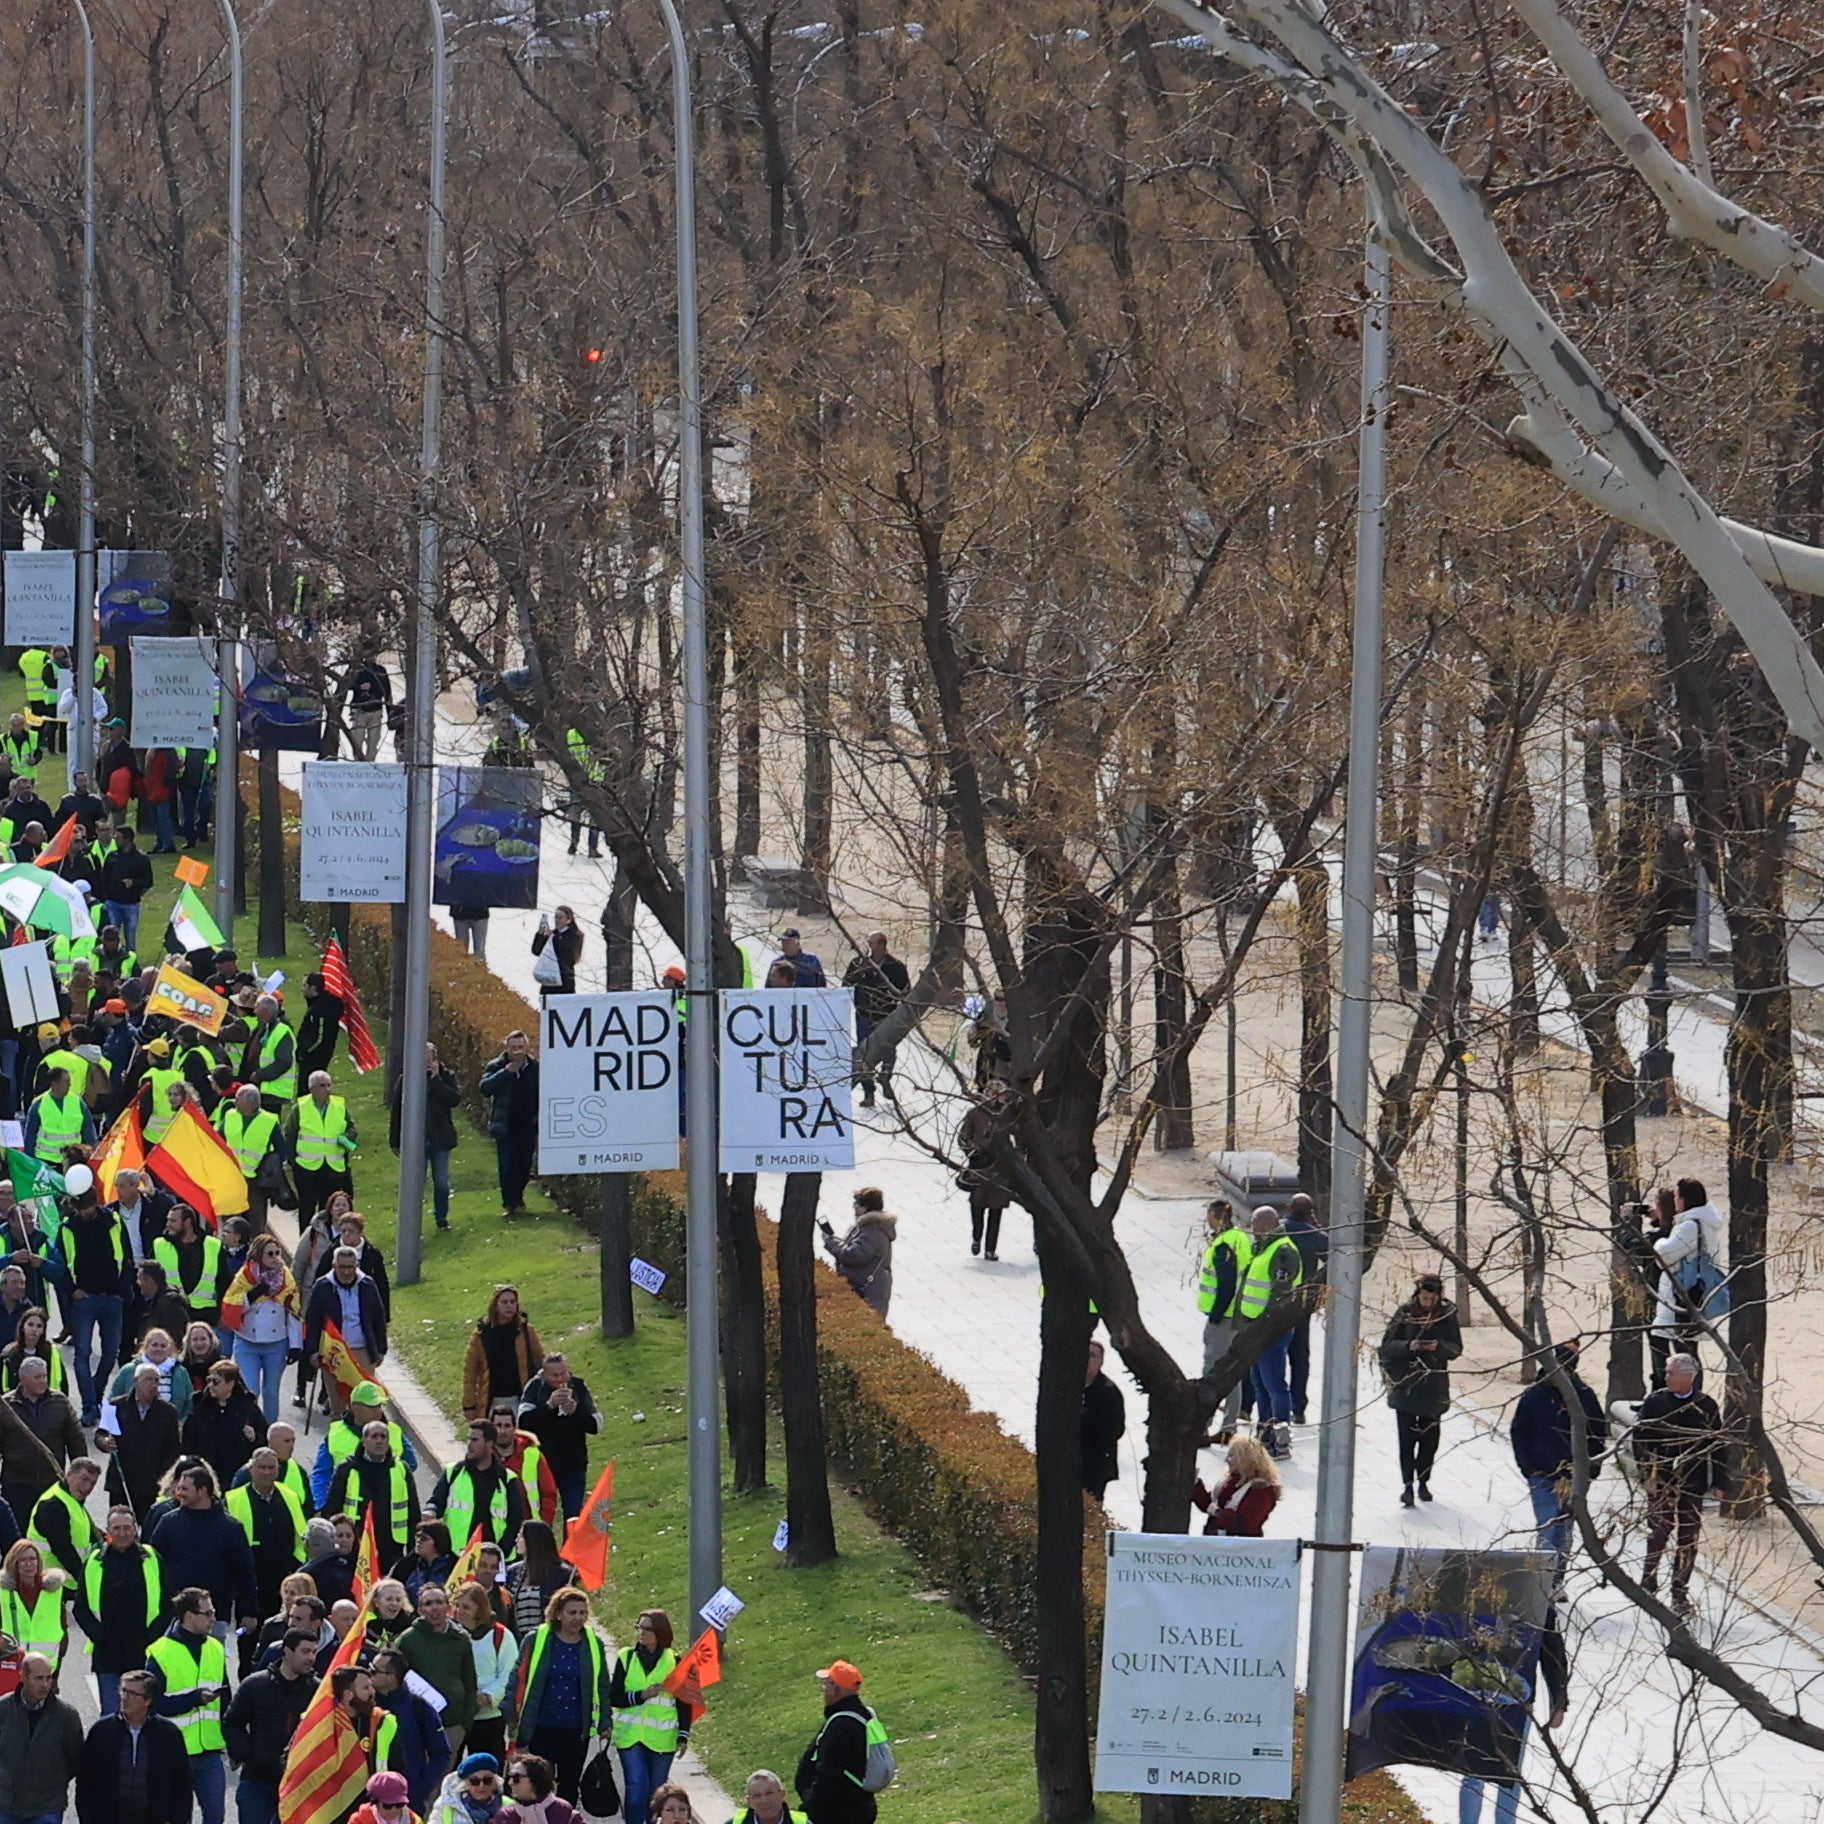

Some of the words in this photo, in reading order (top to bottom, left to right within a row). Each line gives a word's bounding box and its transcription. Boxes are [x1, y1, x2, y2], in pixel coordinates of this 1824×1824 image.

[154, 676, 189, 684] ISABEL
[136, 688, 210, 698] QUINTANILLA
[331, 810, 376, 822] ISABEL
[305, 826, 402, 839] QUINTANILLA
[340, 888, 379, 897] MADRID
[156, 982, 213, 1017] COAG
[548, 1005, 671, 1049] MAD
[727, 1005, 827, 1046] CUL
[592, 1049, 671, 1092] RID
[743, 1051, 809, 1088] TU
[548, 1095, 607, 1140] ES
[779, 1096, 846, 1140] RA
[594, 1152, 644, 1164] MADRID
[770, 1153, 820, 1165] MADRID
[1132, 1552, 1188, 1568] MUSEO
[1191, 1555, 1275, 1571] NACIONAL
[1116, 1570, 1292, 1591] THYSSEN-BORNEMISZA
[1159, 1626, 1243, 1648] ISABEL
[1111, 1652, 1286, 1678] QUINTANILLA
[1171, 1770, 1241, 1786] MADRID
